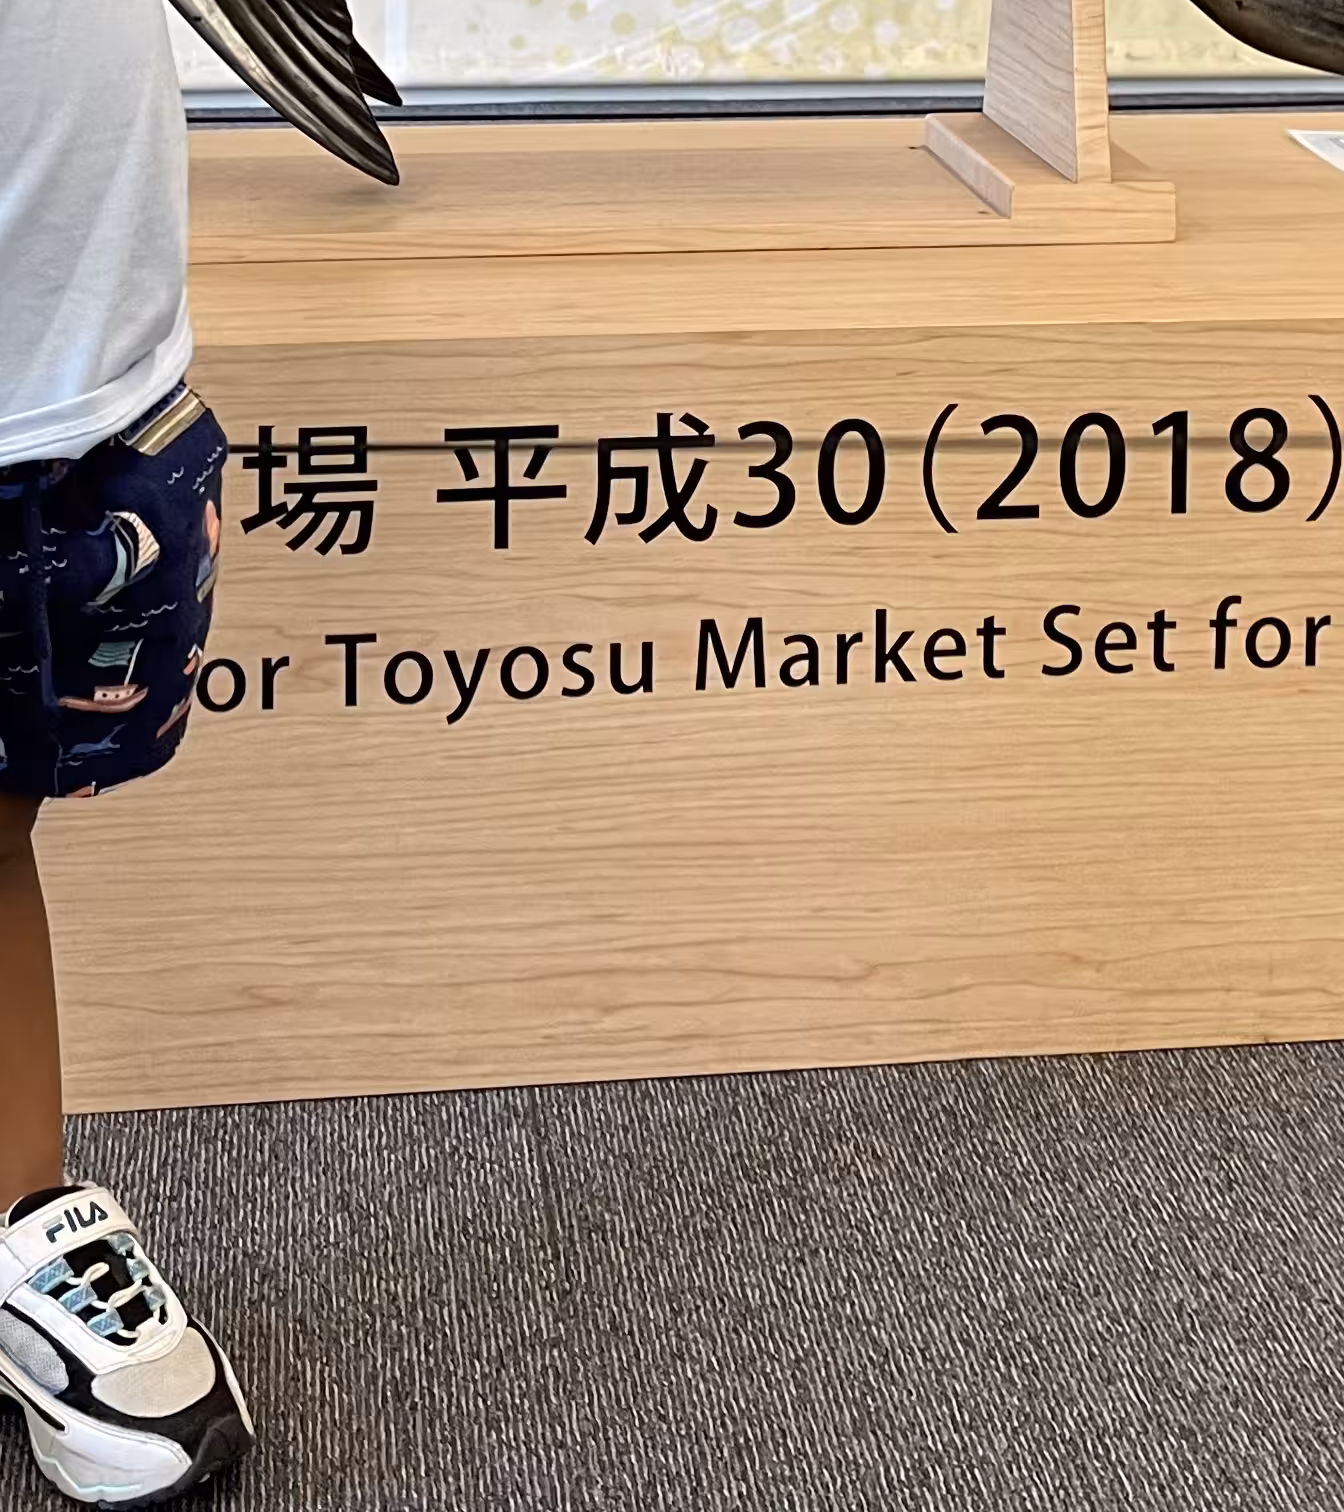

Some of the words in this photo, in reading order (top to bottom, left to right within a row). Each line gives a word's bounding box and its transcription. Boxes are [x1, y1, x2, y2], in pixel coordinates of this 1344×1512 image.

[324, 632, 655, 725] Toyosu
[695, 608, 1006, 692] Market
[1040, 603, 1176, 678] Set
[1210, 595, 1331, 670] for
[43, 1203, 109, 1243] FILA
